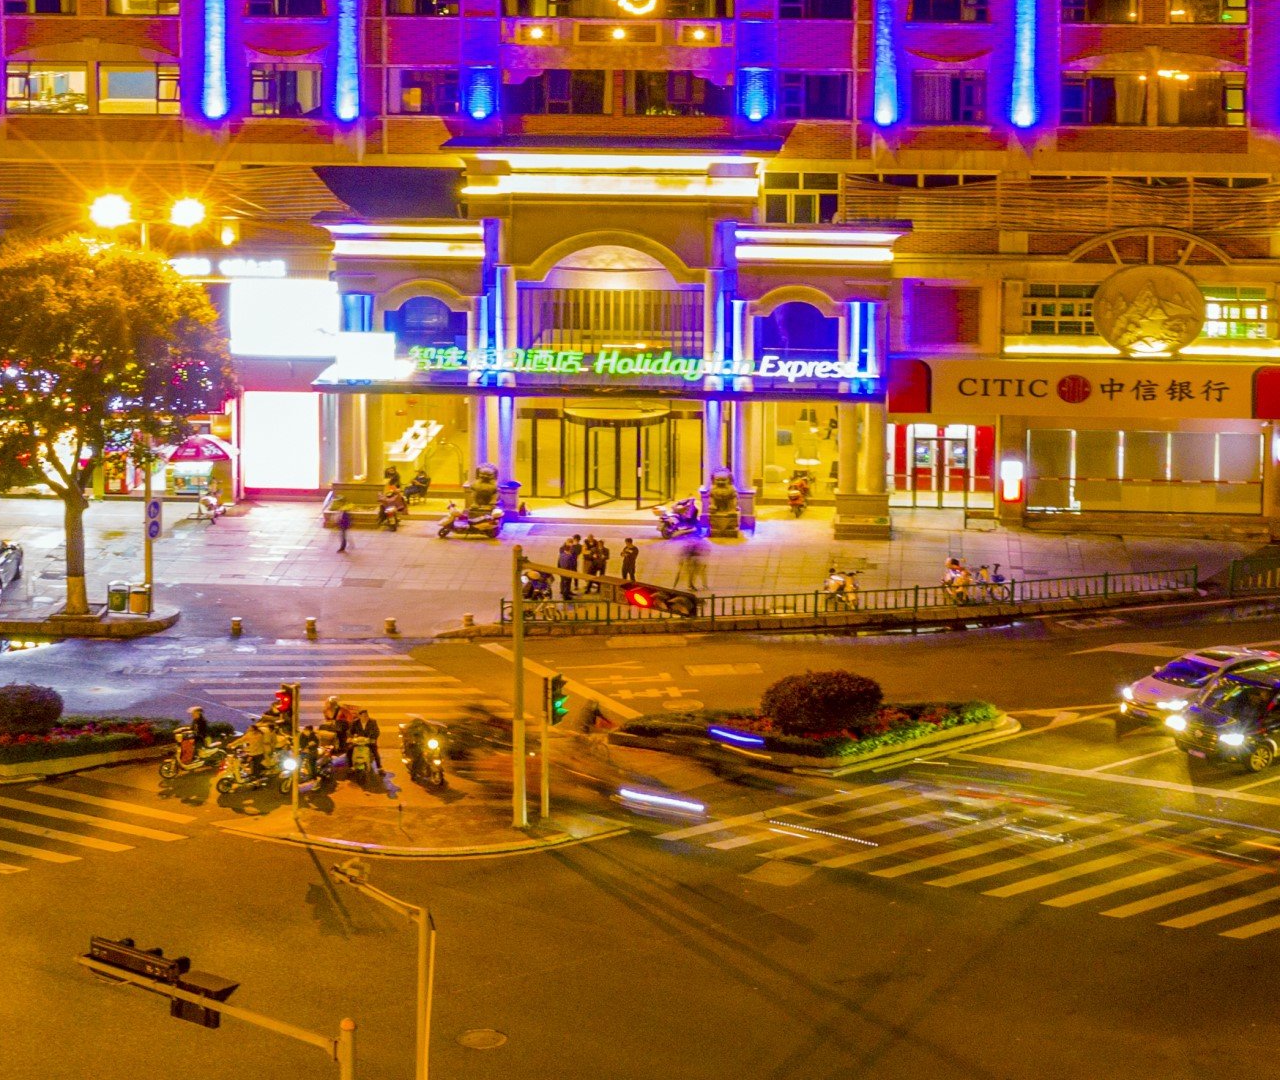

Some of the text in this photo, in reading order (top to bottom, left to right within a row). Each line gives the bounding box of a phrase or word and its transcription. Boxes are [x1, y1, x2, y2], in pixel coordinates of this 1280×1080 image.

[594, 350, 705, 382] Holiday
[758, 354, 860, 382] Express
[957, 377, 1049, 398] CITIC
[1099, 378, 1231, 403] 中信银行
